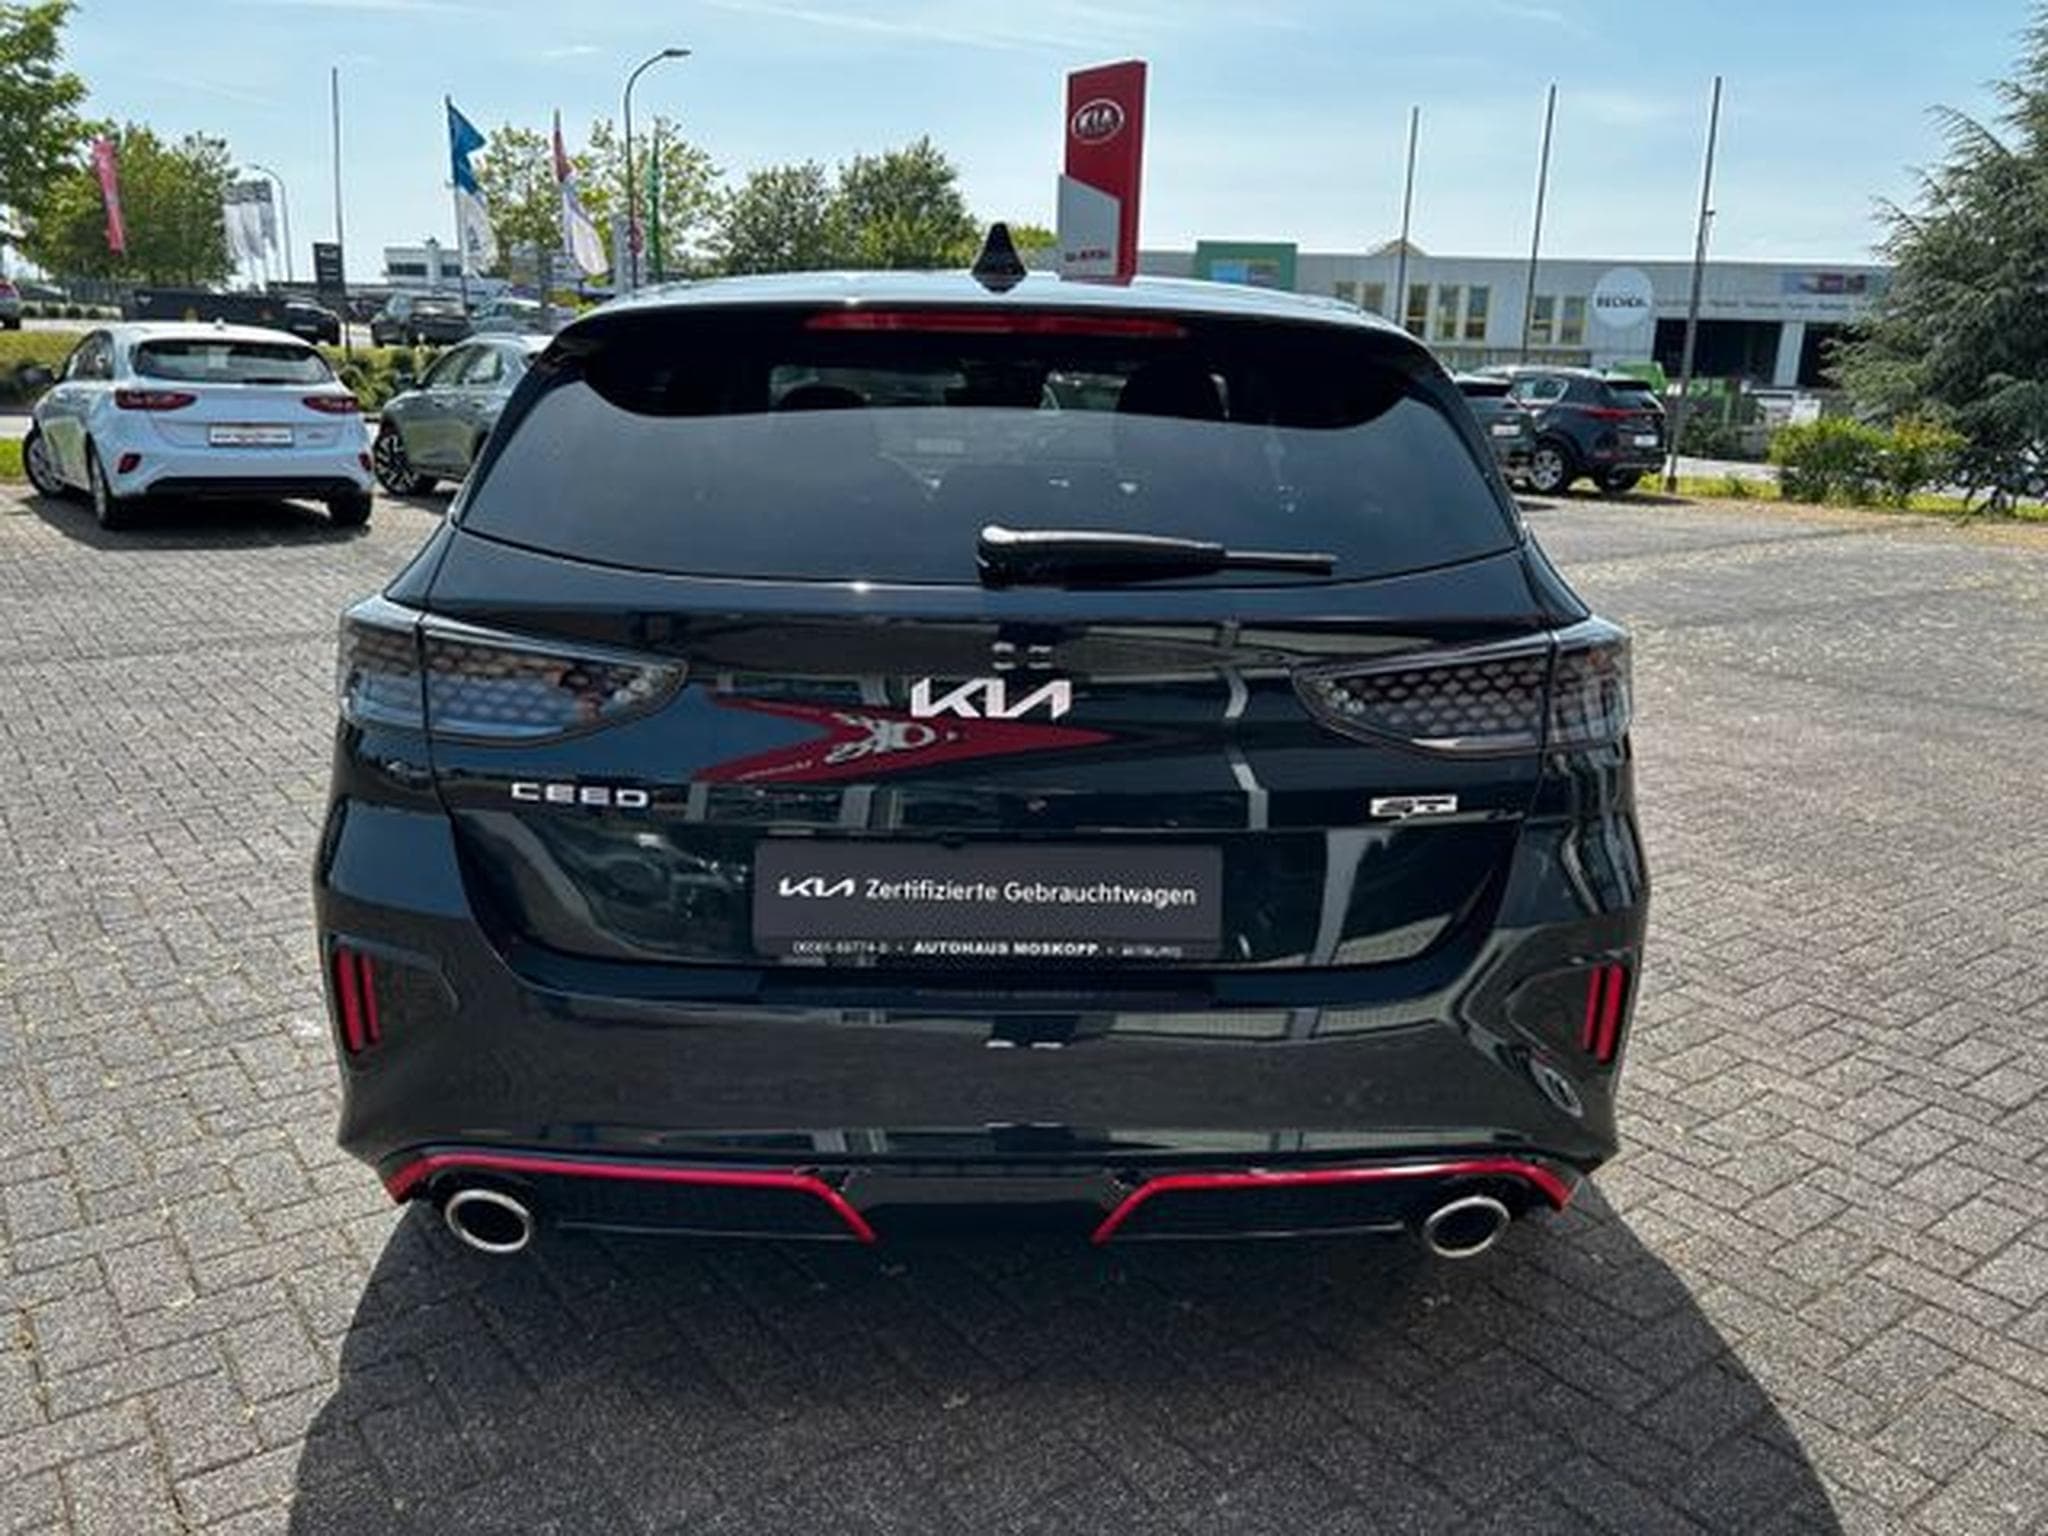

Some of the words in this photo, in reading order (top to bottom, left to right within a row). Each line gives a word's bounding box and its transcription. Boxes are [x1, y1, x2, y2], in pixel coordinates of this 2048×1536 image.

[911, 677, 1071, 719] KIA
[779, 876, 856, 898] KIA
[865, 878, 998, 902] Zertifizierte
[1003, 881, 1197, 909] Gebrauchtwagen
[912, 940, 1009, 956] AUTOHAUS
[1013, 940, 1099, 957] MOSKOPP
